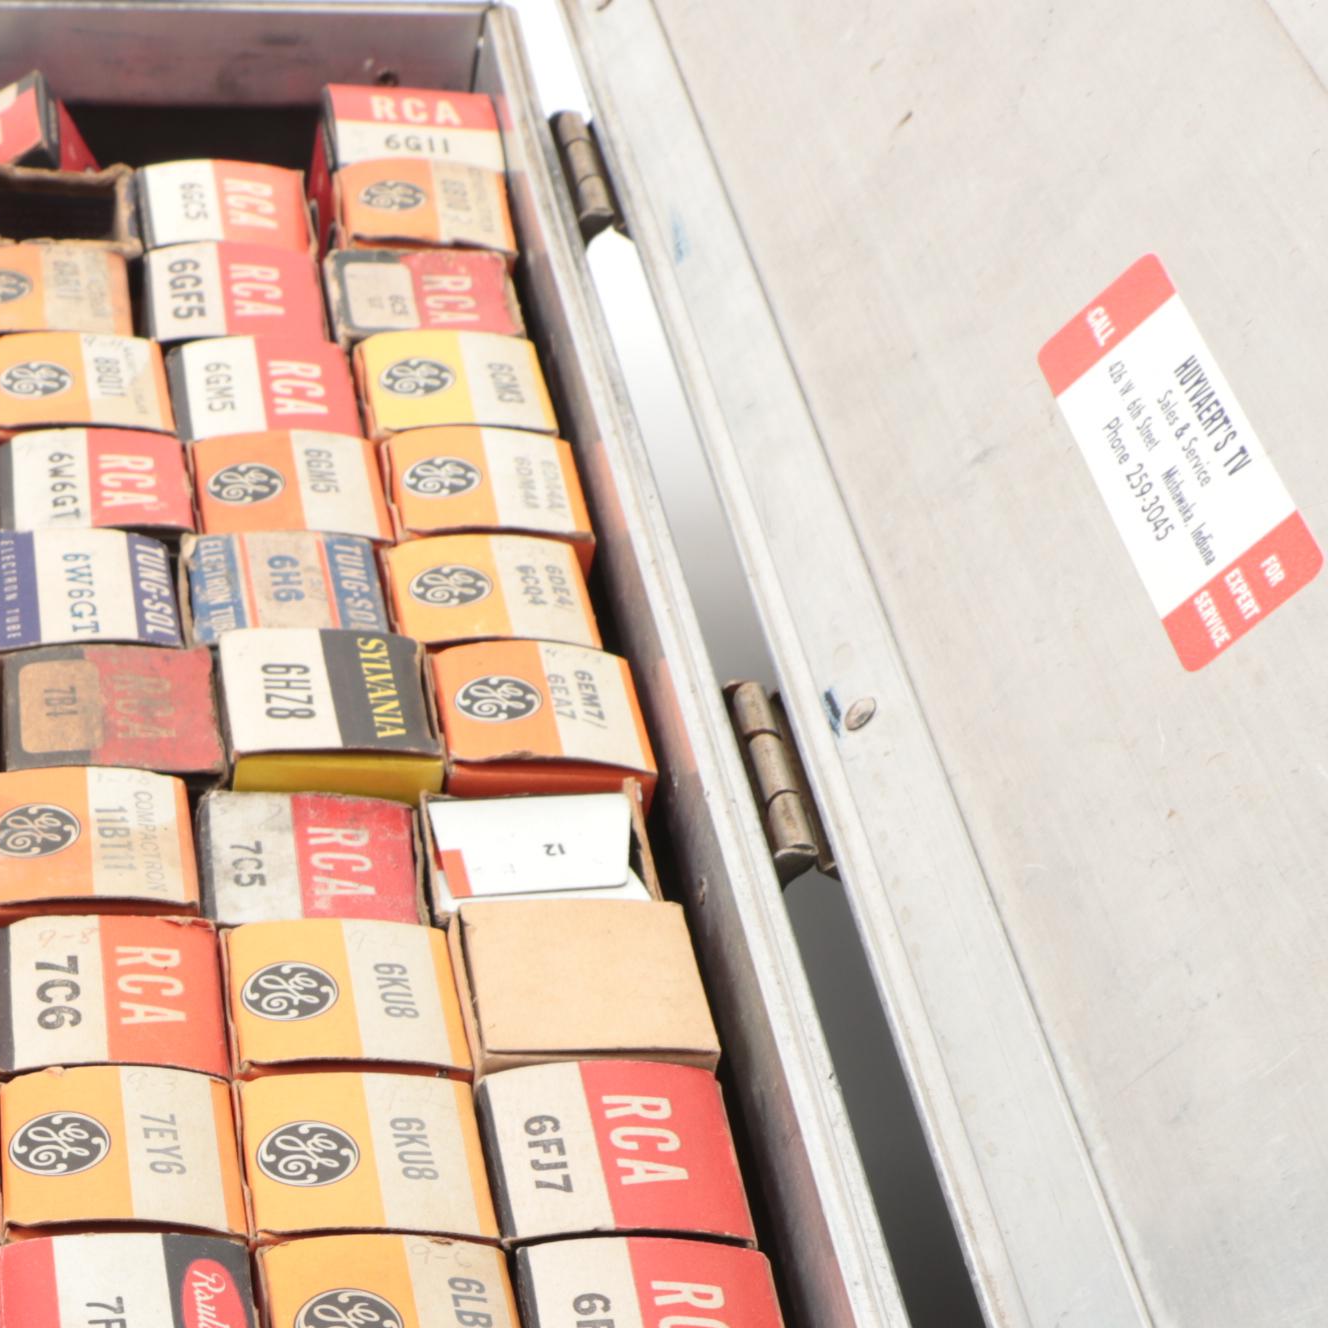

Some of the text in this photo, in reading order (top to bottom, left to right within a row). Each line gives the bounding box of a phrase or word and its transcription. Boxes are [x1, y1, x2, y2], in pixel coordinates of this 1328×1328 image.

[371, 95, 461, 126] RCA
[385, 134, 450, 154] 6G11
[224, 178, 277, 229] RCA
[168, 260, 205, 320] 6GF5
[230, 264, 286, 318] RCA
[421, 274, 480, 324] RCA
[1086, 306, 1116, 347] CALL
[204, 362, 235, 413] 6GM5
[268, 360, 328, 416] RCA
[1173, 355, 1252, 477] HUYVAERT'S TV
[1102, 417, 1131, 466] Phone
[1156, 390, 1212, 488] Sales & Service
[47, 452, 81, 520] 6W6GT
[98, 454, 159, 507] RCA
[304, 449, 339, 494] 6GM5
[1126, 396, 1142, 420] 6th
[1135, 415, 1160, 452] Street
[1190, 523, 1216, 567] Indiana
[0, 540, 22, 639] ELECTRON TUBE
[62, 553, 99, 634] 6W6GT
[135, 544, 176, 635] TUNG-SOL
[199, 540, 232, 603] ELECTRON
[267, 555, 305, 602] 6H6
[1224, 567, 1260, 621] EXPERT
[1260, 555, 1286, 587] FOR
[1193, 590, 1231, 649] SERVICE
[115, 673, 176, 739] RCA
[261, 662, 315, 719] 6HZ8
[356, 638, 407, 738] SYLVANIA
[548, 673, 577, 720] 6EA7
[133, 791, 166, 892] COMPACTRON
[229, 840, 267, 888] 7C5
[306, 827, 376, 897] RCA
[34, 955, 82, 1031] 7C6
[114, 945, 186, 1026] RCA
[372, 962, 421, 1020] 6KU8
[138, 1113, 187, 1176] 7EY6
[390, 1117, 439, 1181] 6KU8
[523, 1114, 574, 1193] 6FJ7
[600, 1094, 689, 1185] RCA
